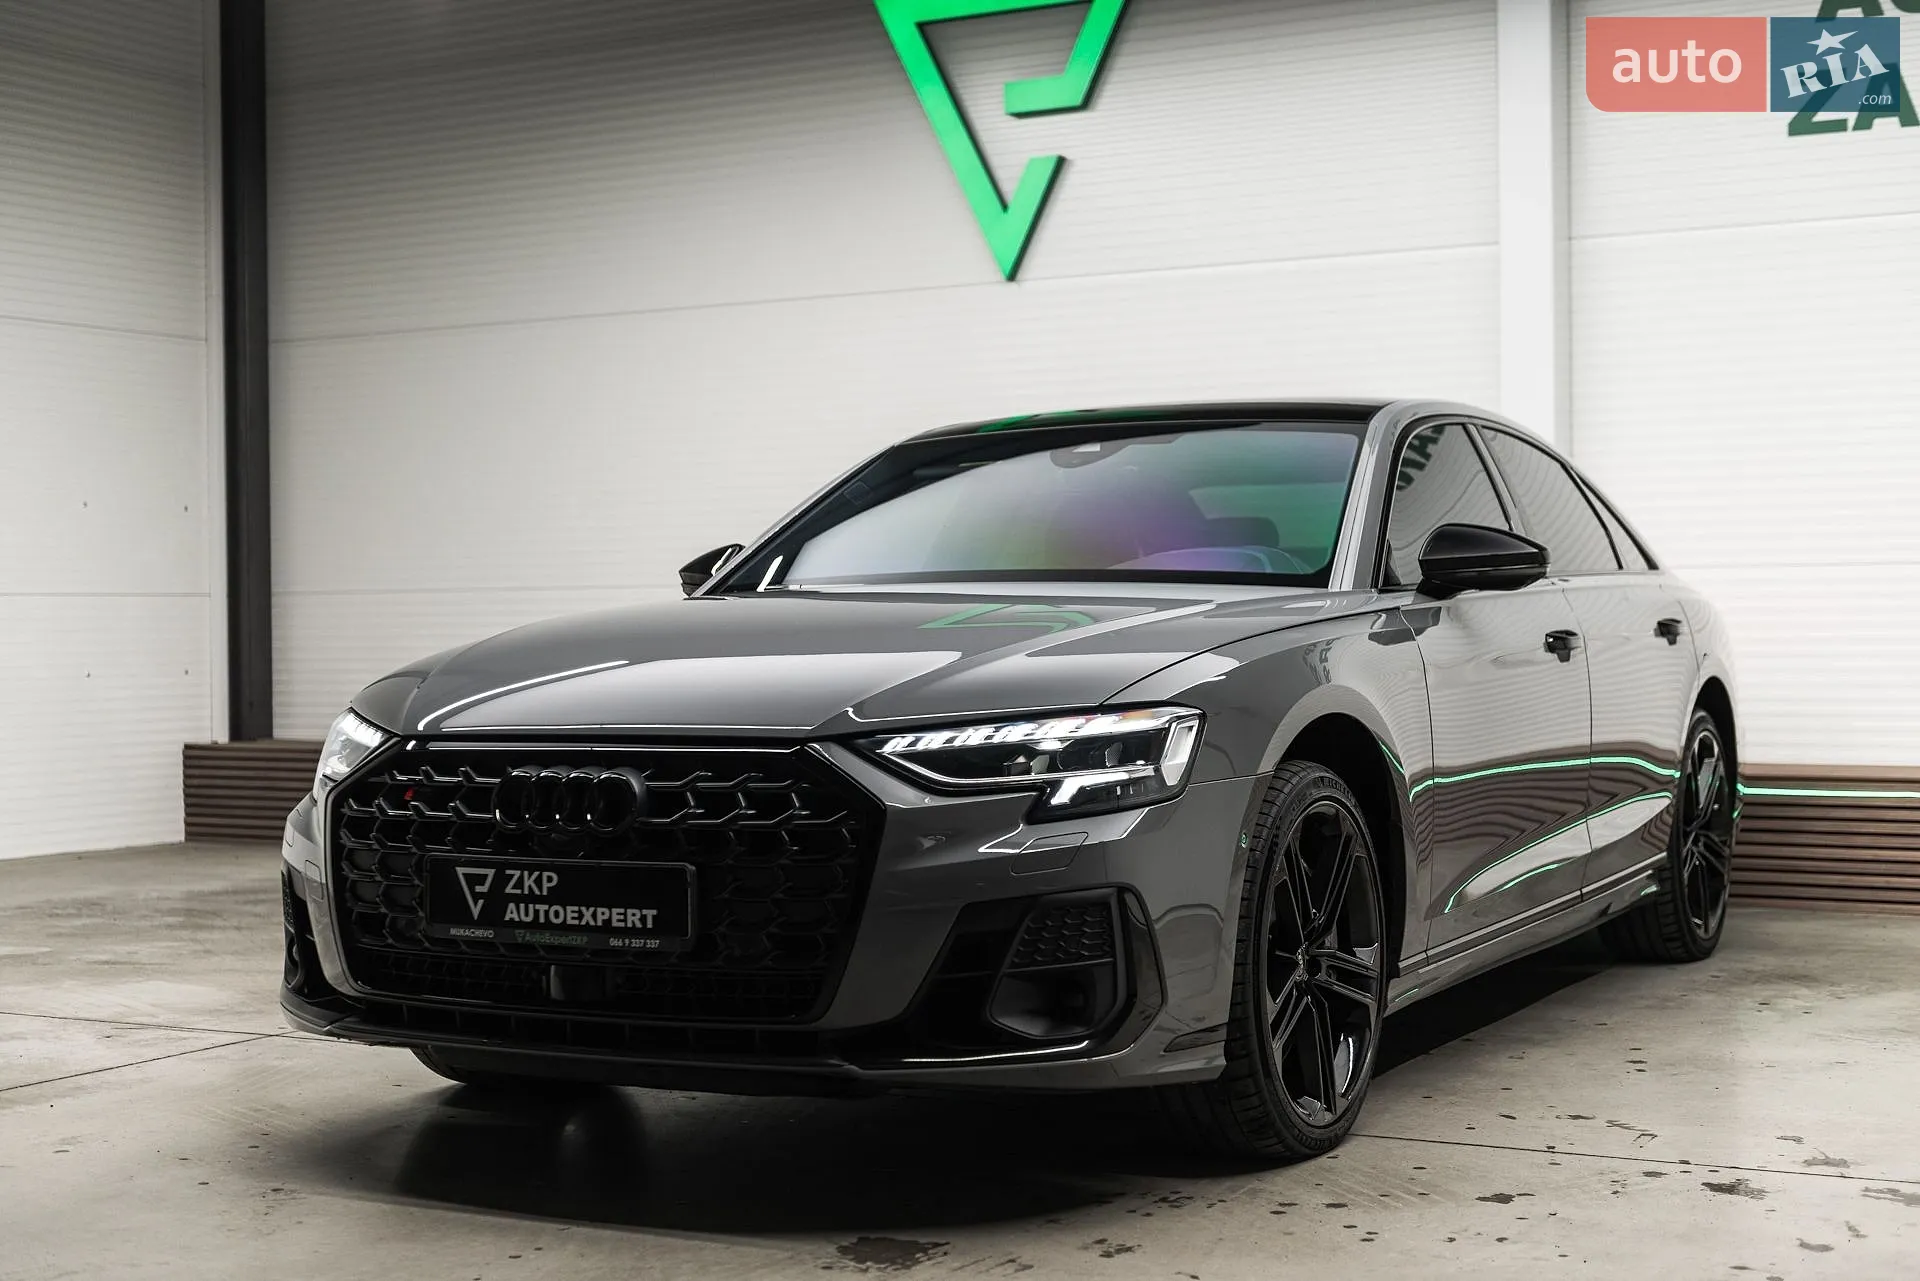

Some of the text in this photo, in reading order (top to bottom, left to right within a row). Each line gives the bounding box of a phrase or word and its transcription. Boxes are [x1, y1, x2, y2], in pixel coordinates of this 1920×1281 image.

[504, 869, 559, 896] ZKP
[504, 902, 658, 929] AUTOEXPERT
[449, 927, 495, 939] MUKACHEVO
[609, 937, 623, 946] 066
